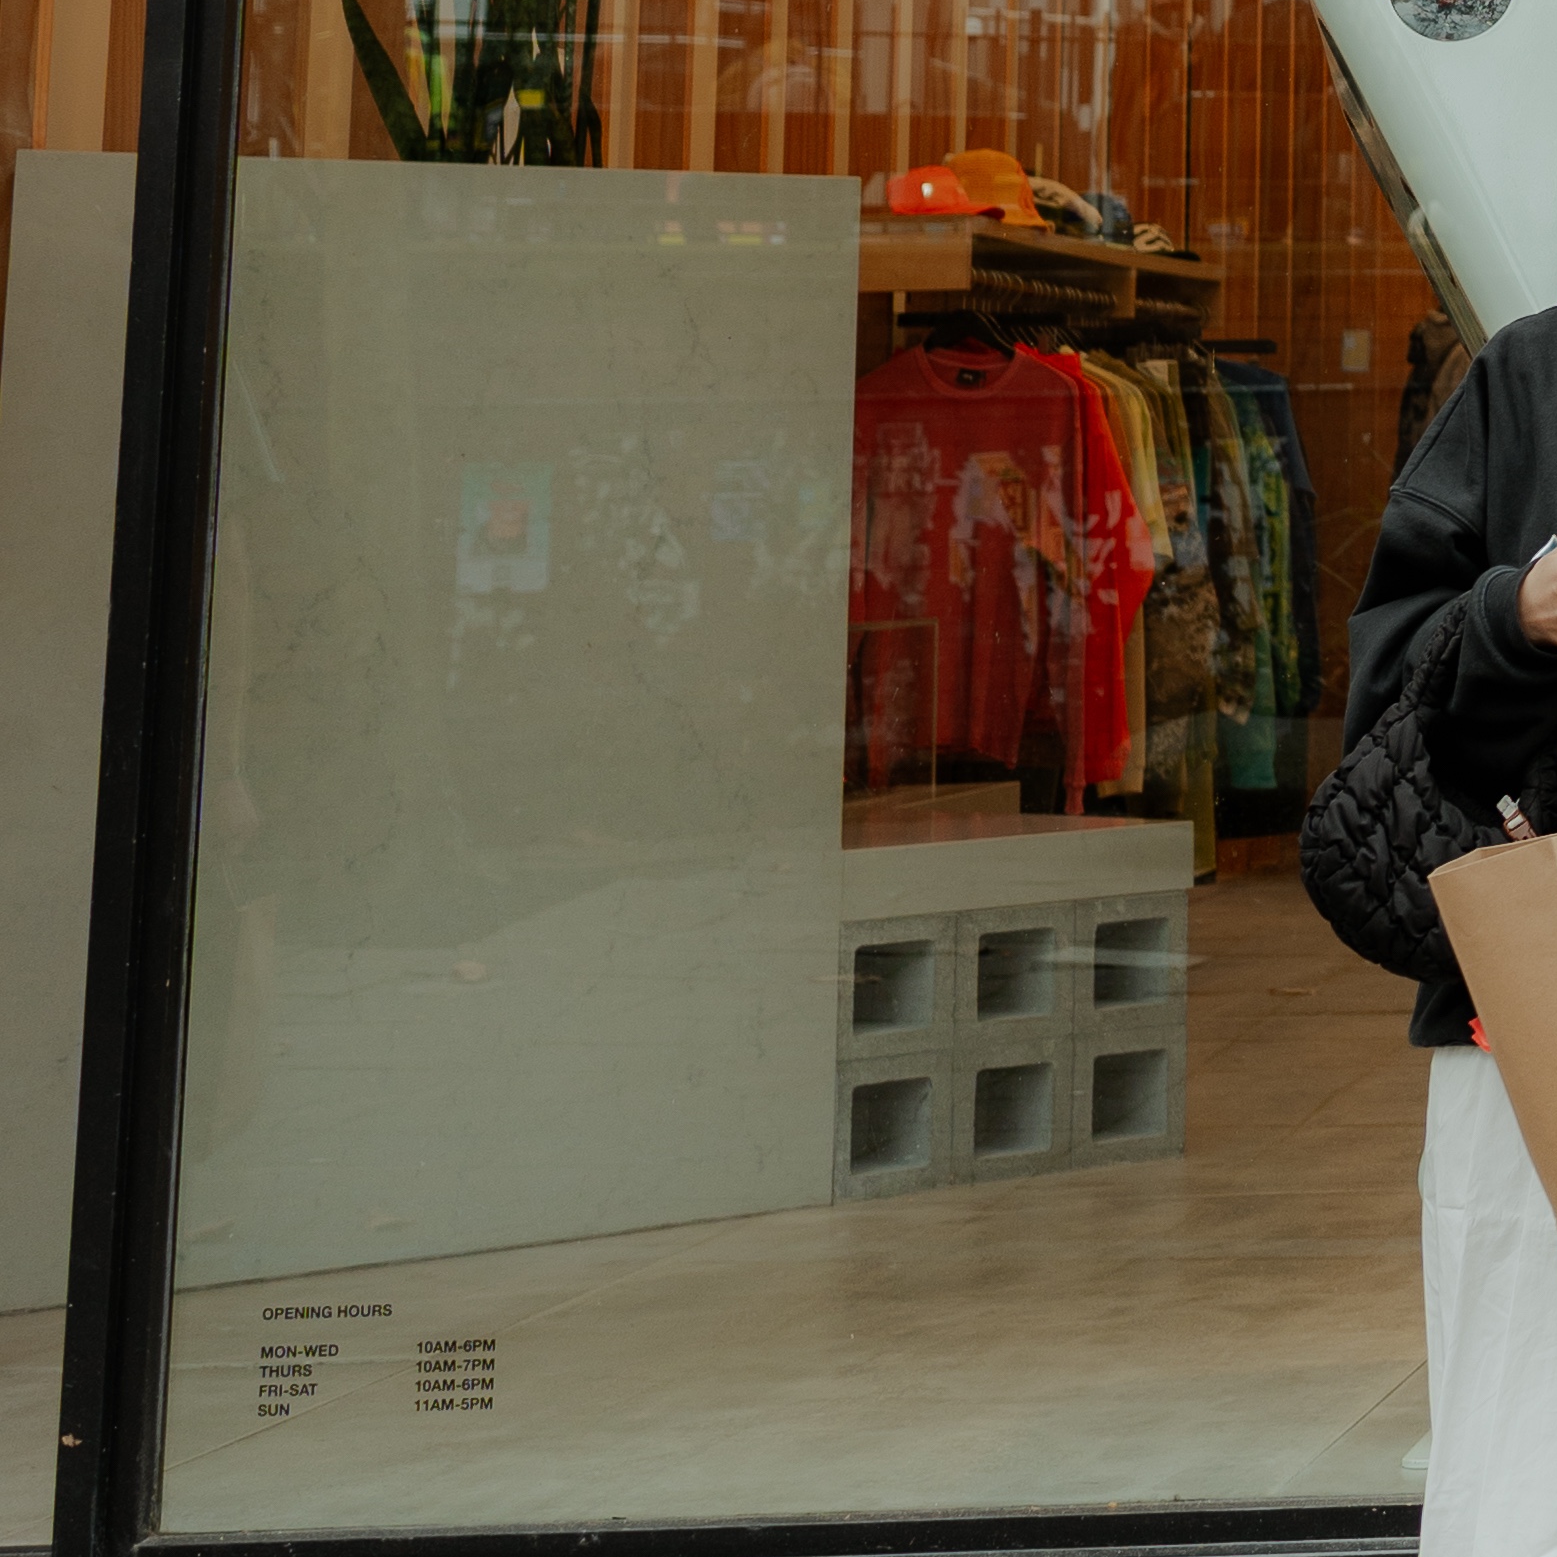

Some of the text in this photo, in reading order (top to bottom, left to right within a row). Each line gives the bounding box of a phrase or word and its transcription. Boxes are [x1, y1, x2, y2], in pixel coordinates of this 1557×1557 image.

[262, 1304, 393, 1320] OPENING HOURS
[260, 1339, 496, 1359] MON-WED 10AM-6PM
[259, 1358, 495, 1378] THURS 10AM-7PM
[258, 1378, 494, 1398] FRI-SAT 10AM-6PM
[257, 1397, 494, 1417] SUN 11AM-5PM
